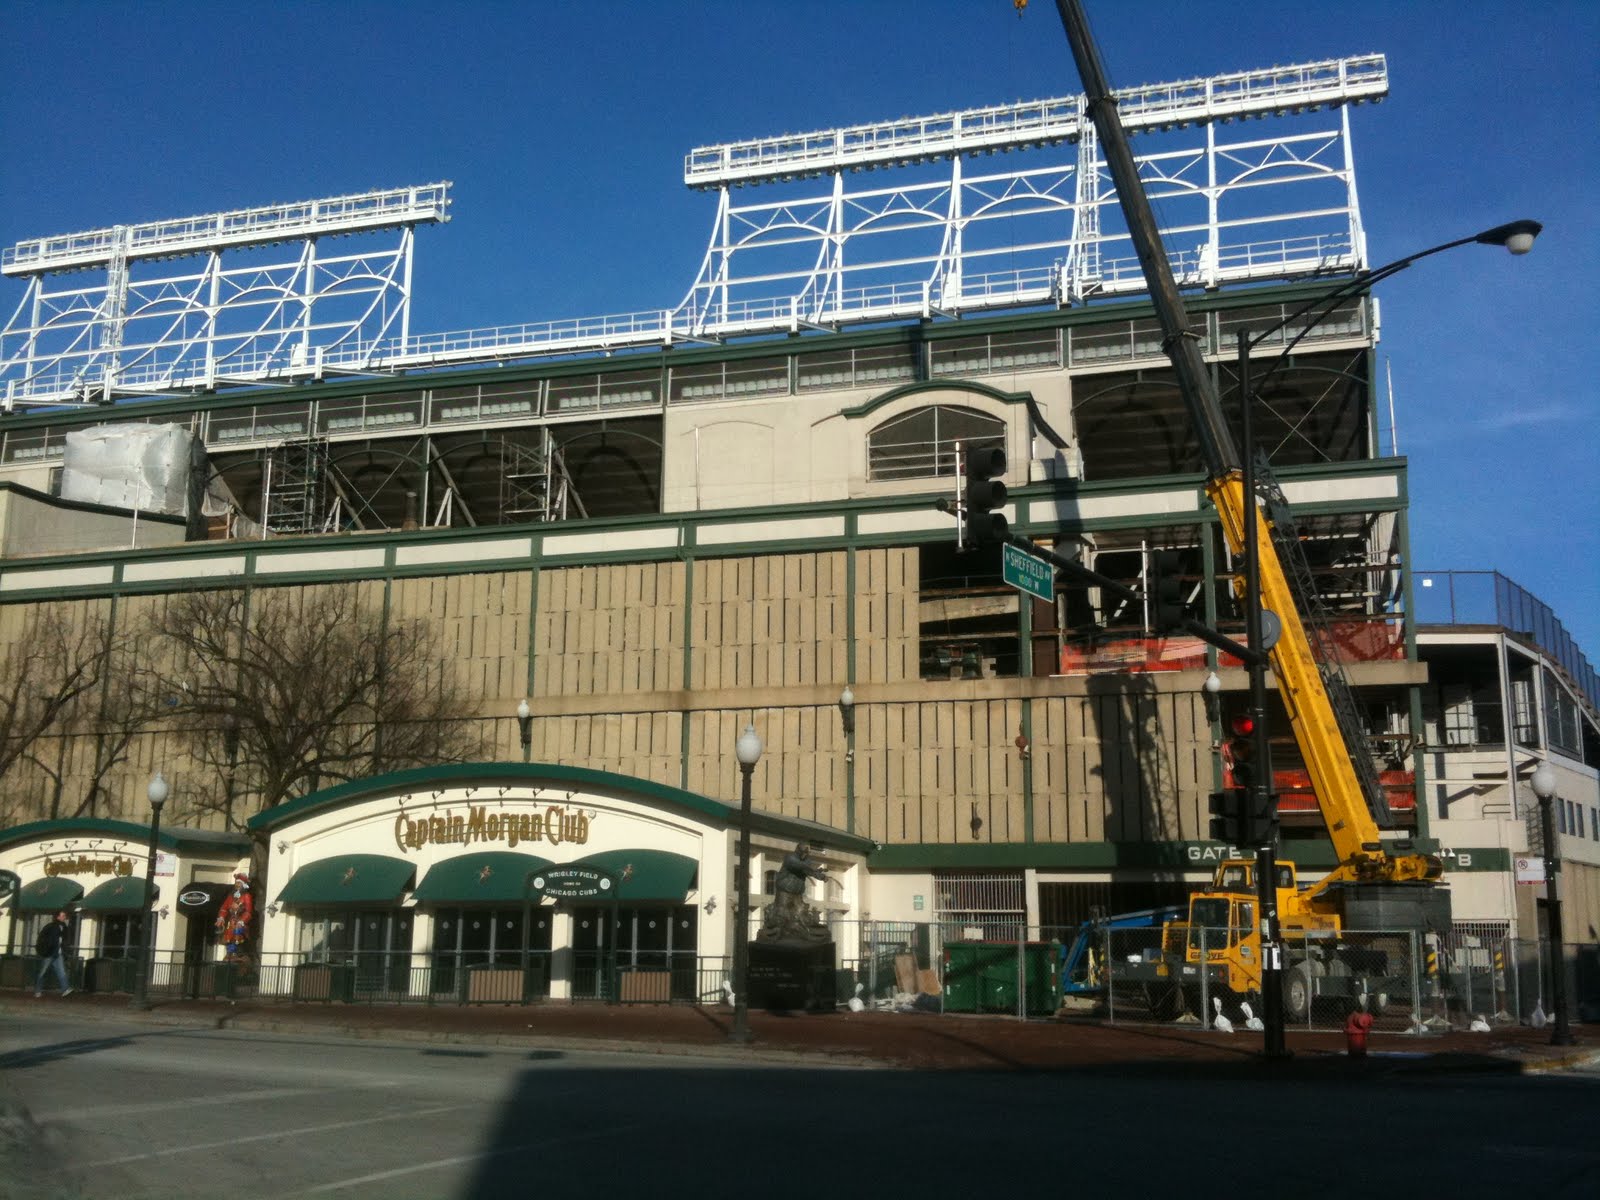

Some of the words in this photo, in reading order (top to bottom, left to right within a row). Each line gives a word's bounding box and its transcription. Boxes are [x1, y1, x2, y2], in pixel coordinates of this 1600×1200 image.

[1011, 552, 1044, 580] SHEFFIELD
[395, 809, 464, 853] Captain
[464, 806, 543, 848] Morgan
[545, 805, 589, 846] Club
[1187, 846, 1243, 860] GATE
[548, 871, 578, 879] WRIGLEY
[579, 871, 599, 880] FIELD
[546, 888, 577, 896] CHICAGO
[579, 888, 598, 896] CUBS
